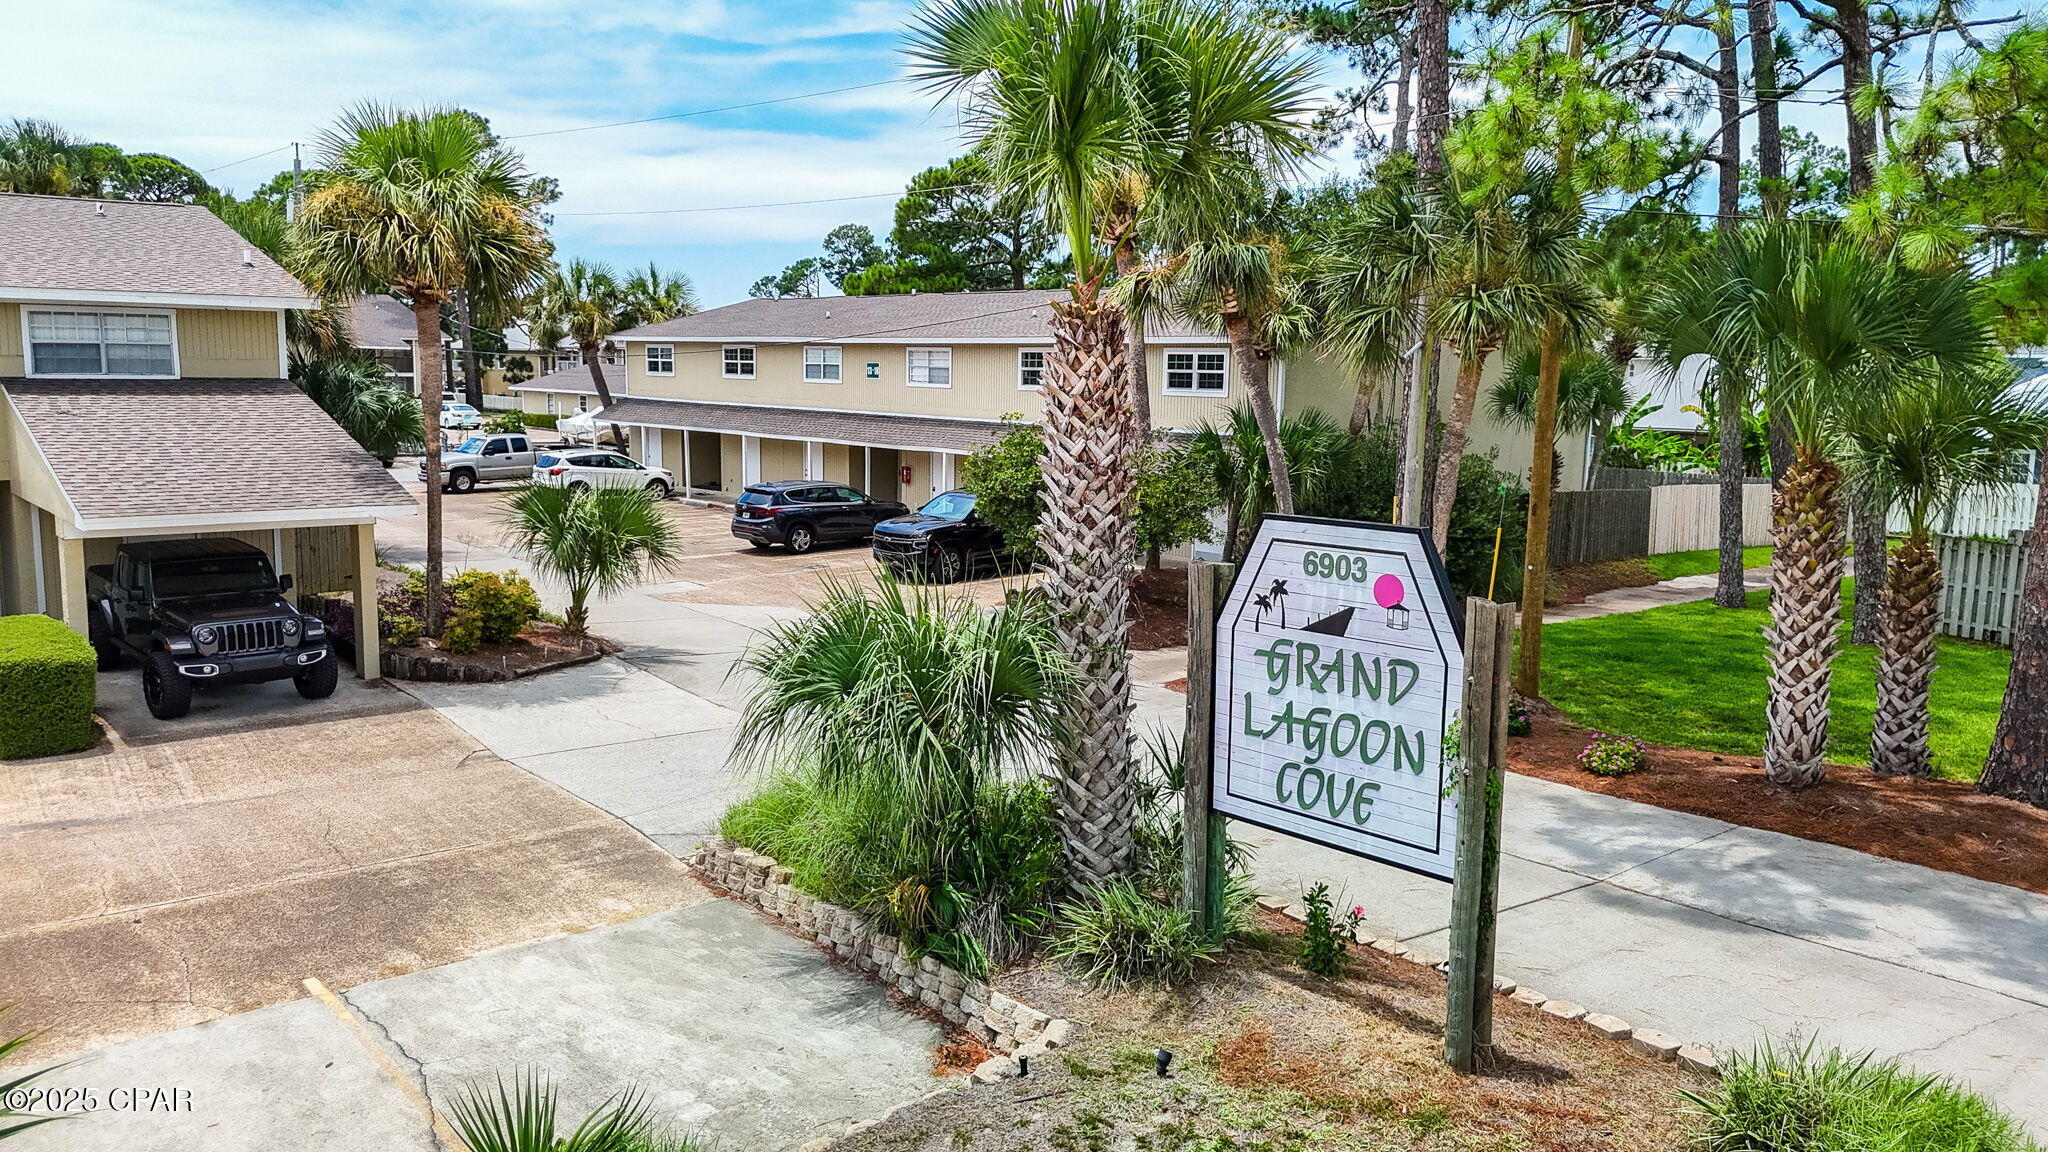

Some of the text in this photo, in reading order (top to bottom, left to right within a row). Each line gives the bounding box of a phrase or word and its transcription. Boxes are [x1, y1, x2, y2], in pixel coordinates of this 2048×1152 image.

[1303, 551, 1367, 582] 6903
[1254, 639, 1420, 705] GRAND
[1244, 692, 1424, 775] LAGOON
[1276, 762, 1381, 825] COVE
